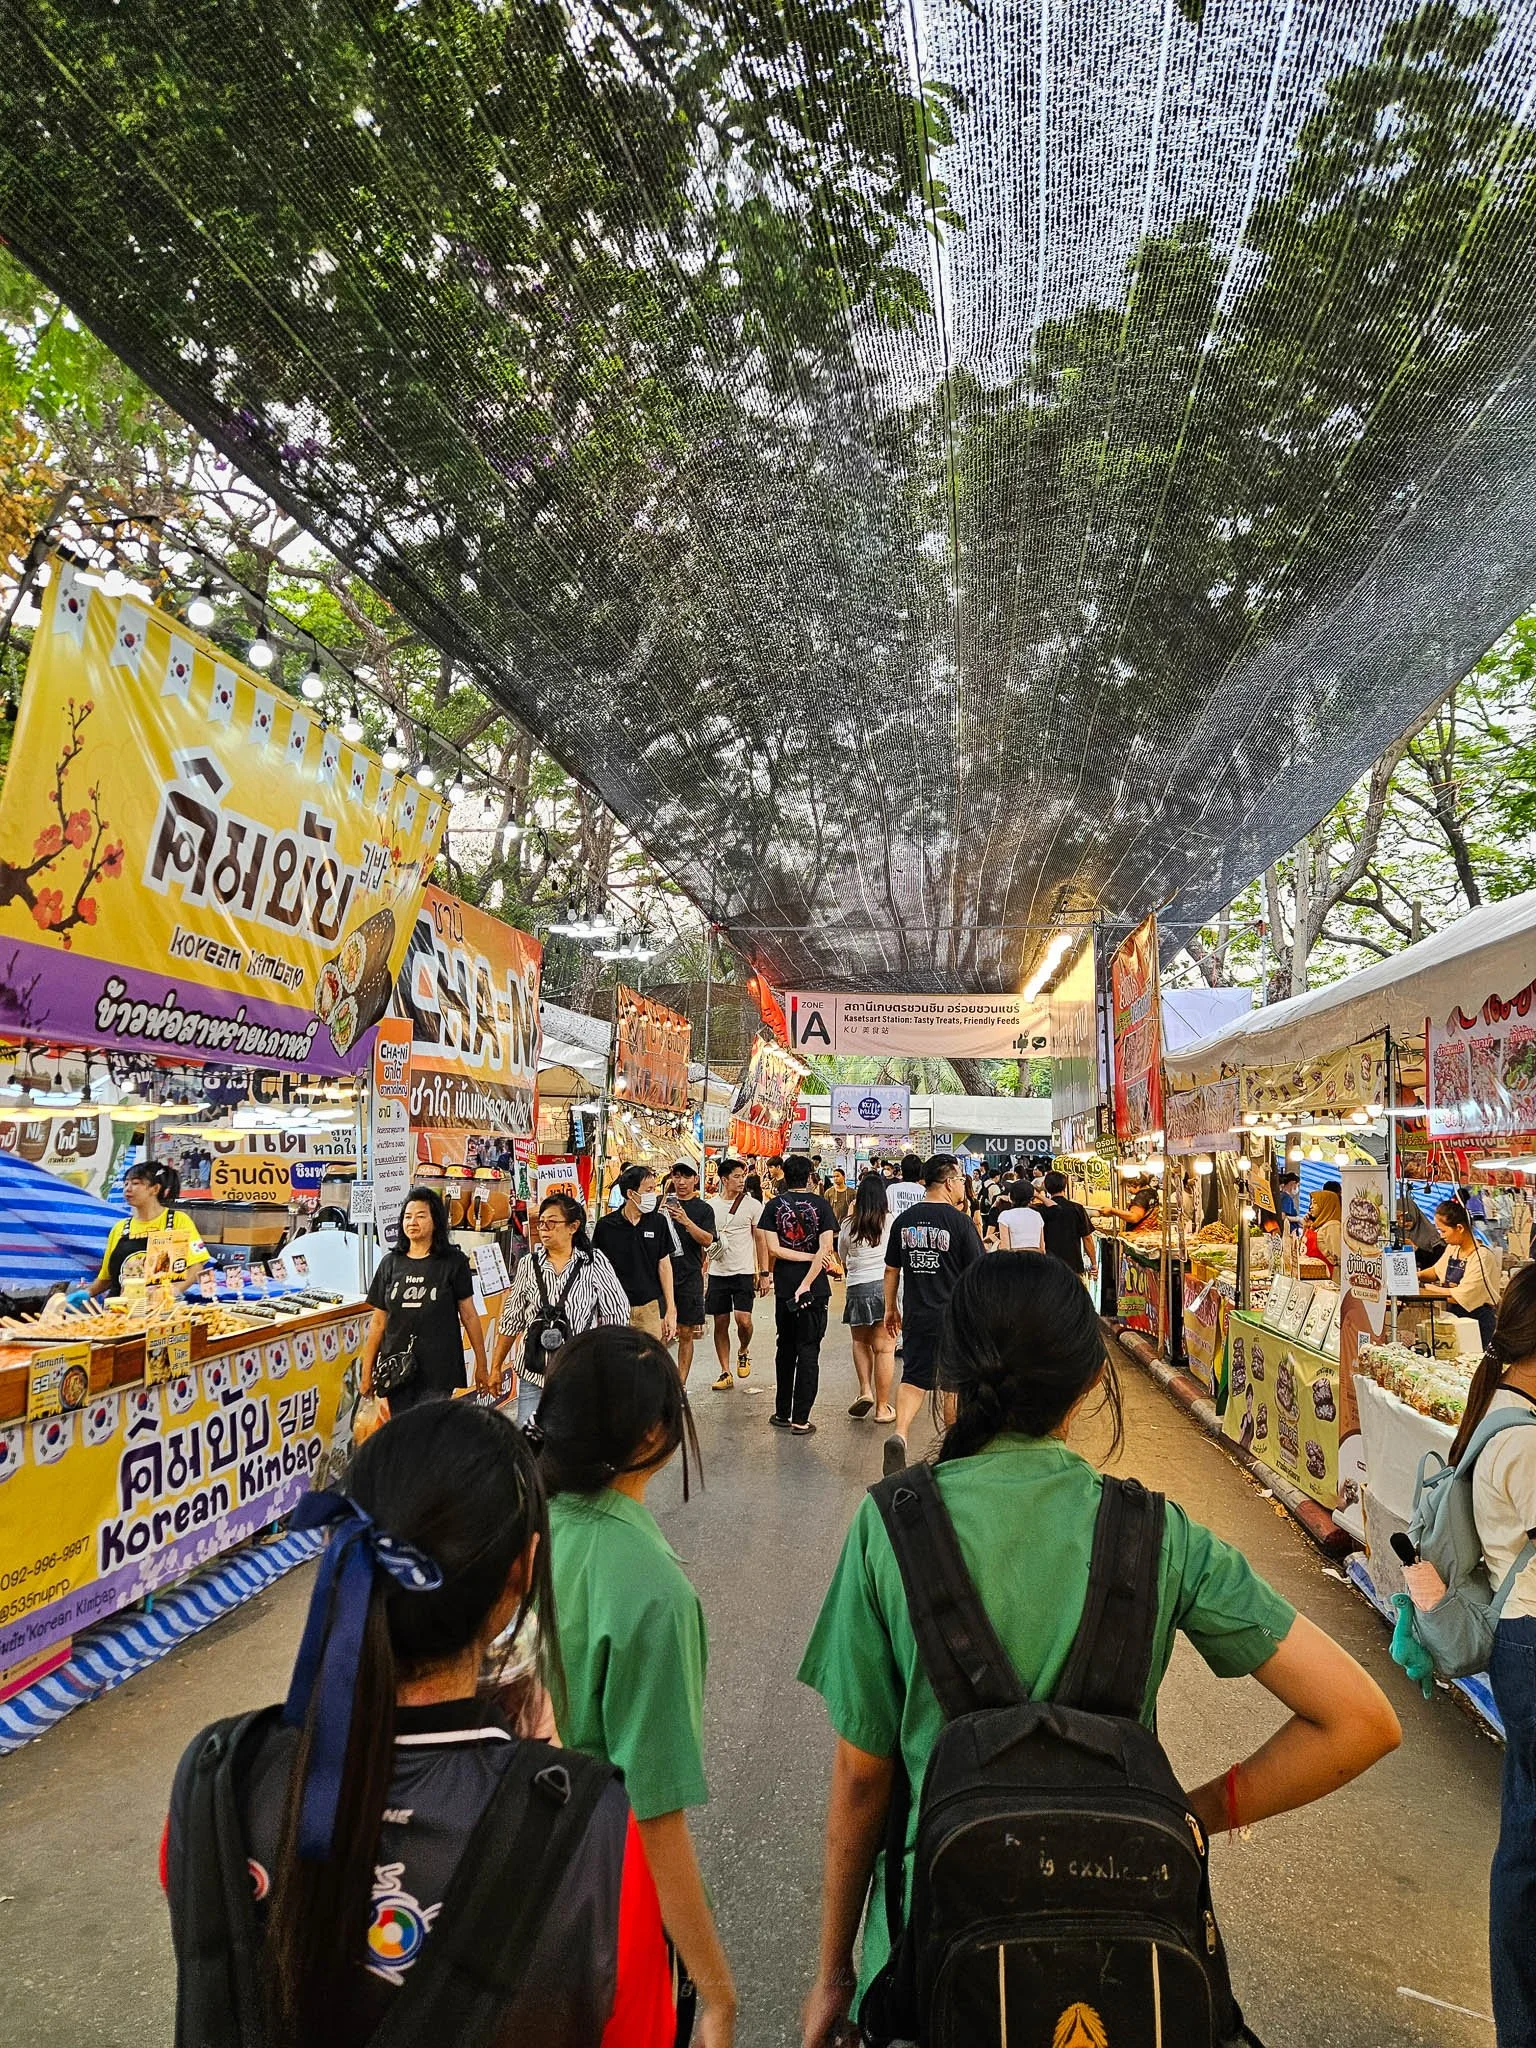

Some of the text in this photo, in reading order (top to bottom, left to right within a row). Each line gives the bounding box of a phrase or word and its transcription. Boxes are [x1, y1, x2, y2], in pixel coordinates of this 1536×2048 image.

[96, 975, 319, 1061] ข้าวห่อสาหร่ายเกาหลี
[844, 1001, 1020, 1014] สถานีเกษตรชวนชิม อร่อยชวนแชร์
[844, 1015, 1020, 1025] Kasetsart Station: Tasty Treats, Friendly Feeds
[801, 1010, 831, 1045] A
[844, 1026, 858, 1034] KU
[410, 1076, 453, 1117] ชาใต้
[936, 1134, 952, 1144] KU
[986, 1139, 1008, 1151] KU
[214, 1157, 290, 1185] ร้านดัง
[901, 1226, 950, 1251] TOKYO
[909, 1250, 940, 1268] 東京
[405, 1276, 425, 1284] Here
[277, 1387, 319, 1438] 김밥
[120, 1386, 270, 1513] คิมบับ
[102, 1437, 322, 1571] Korean Kimbap
